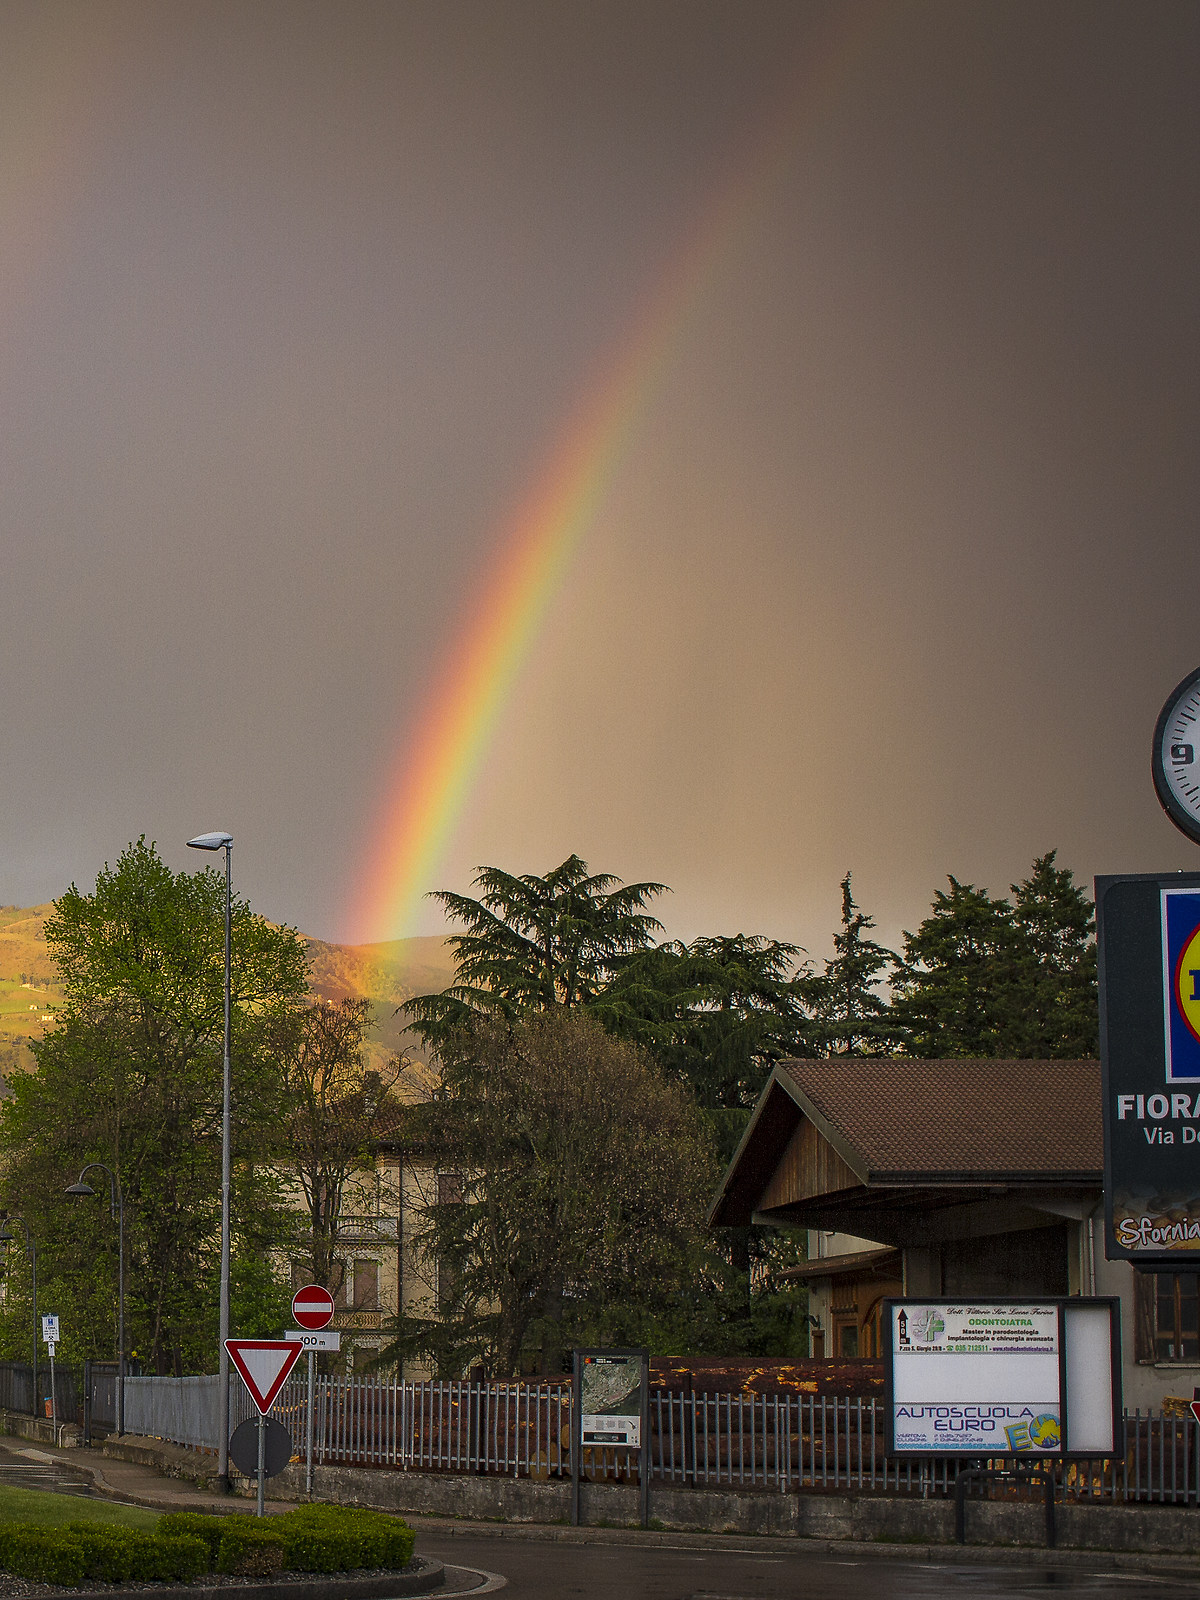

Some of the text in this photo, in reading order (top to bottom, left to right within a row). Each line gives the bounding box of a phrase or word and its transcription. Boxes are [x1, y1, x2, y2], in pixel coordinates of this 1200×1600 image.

[1171, 743, 1194, 766] 9
[1143, 1126, 1200, 1145] Via D
[968, 1318, 1033, 1326] ODONTOIATRA
[955, 1344, 966, 1352] 035
[967, 1344, 988, 1352] 712511
[896, 1407, 1034, 1418] AUTOSCUOLA
[934, 1419, 996, 1431] EURO
